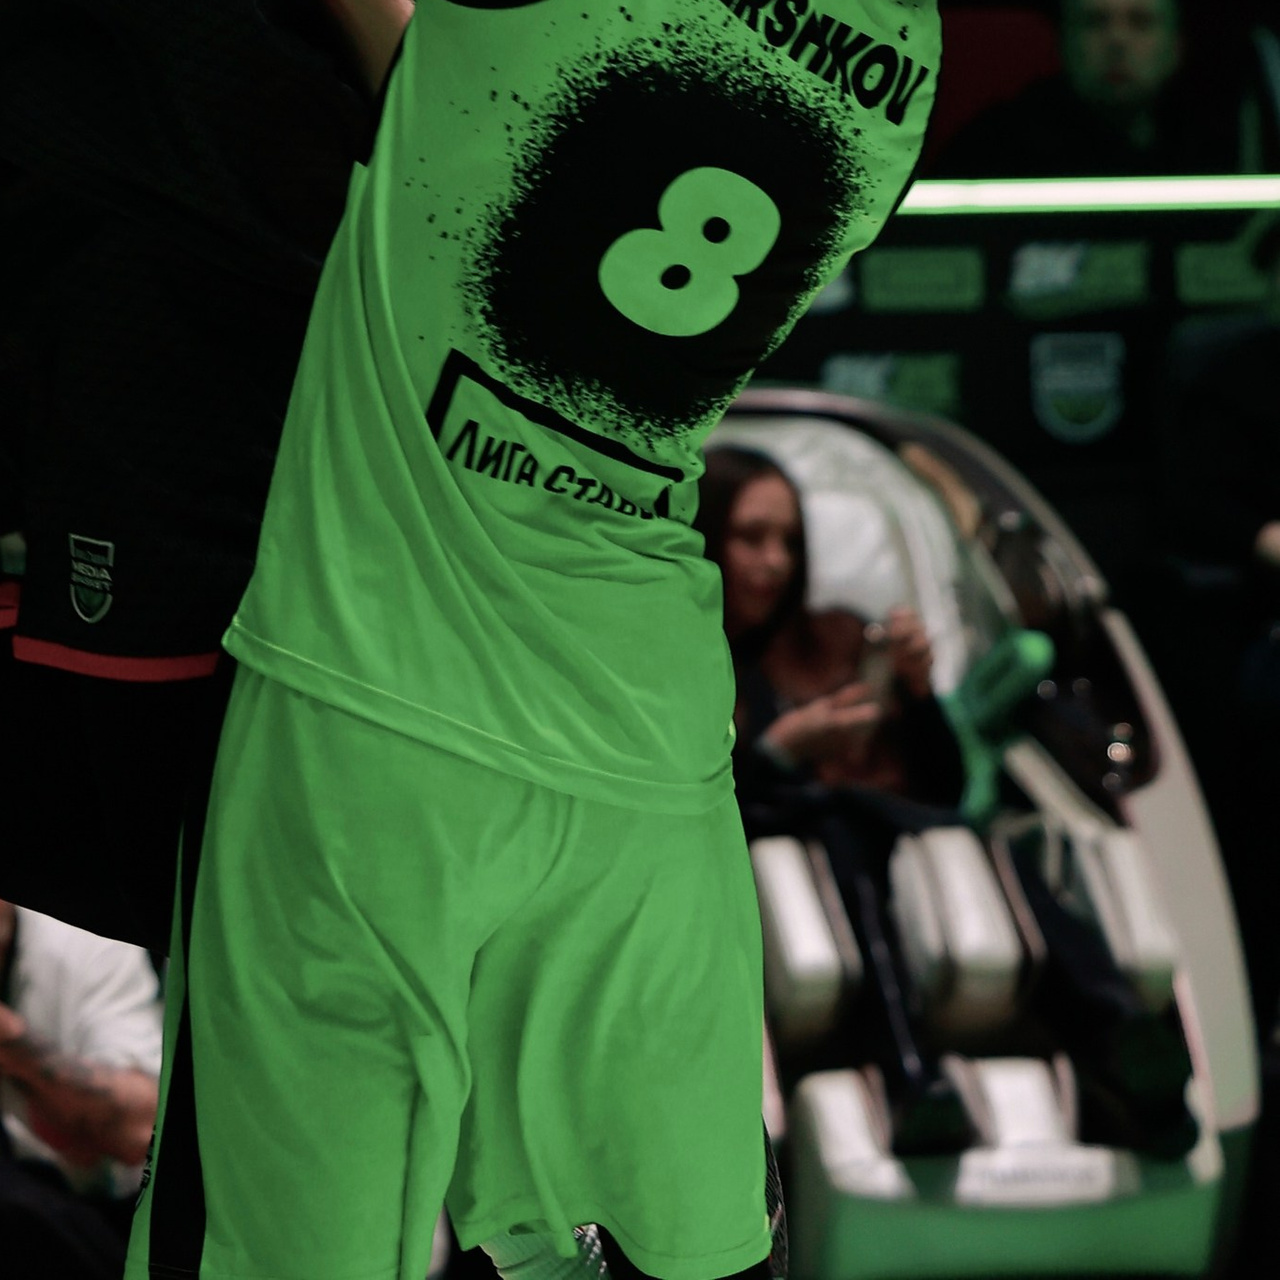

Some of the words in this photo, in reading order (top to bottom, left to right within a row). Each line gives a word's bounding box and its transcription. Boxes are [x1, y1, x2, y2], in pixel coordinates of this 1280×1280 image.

[597, 165, 782, 337] 8
[446, 419, 538, 487] ЛИГА
[543, 465, 654, 520] СТАВ
